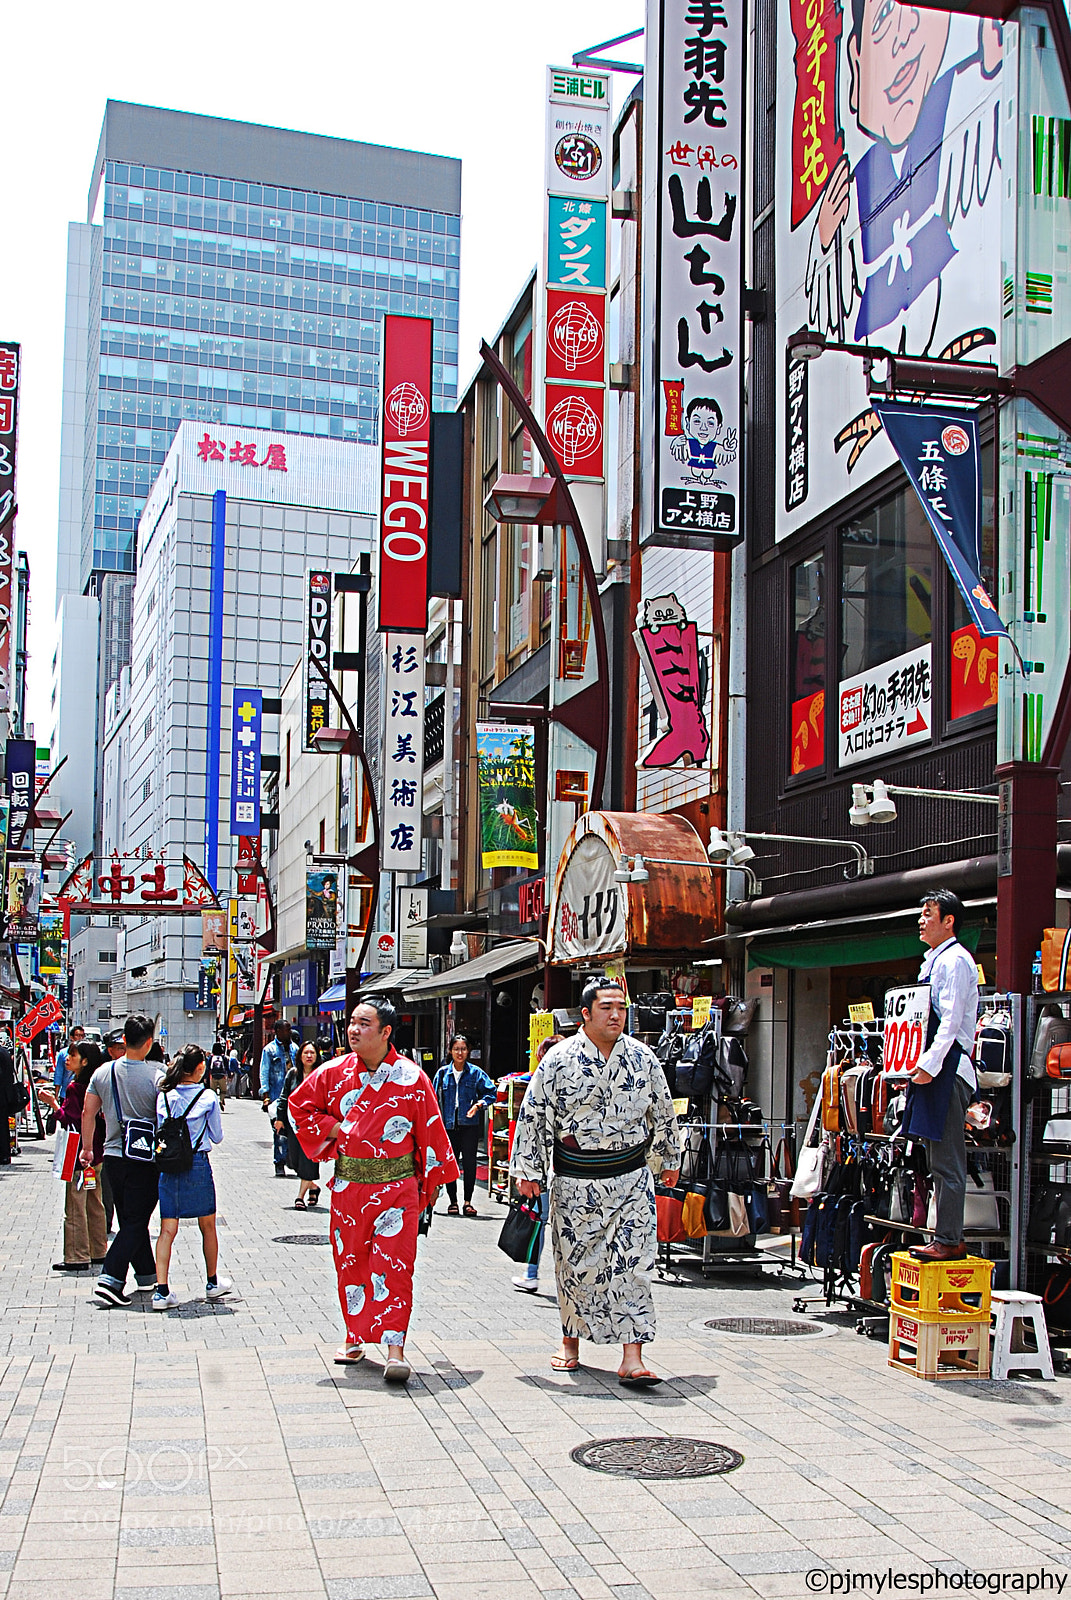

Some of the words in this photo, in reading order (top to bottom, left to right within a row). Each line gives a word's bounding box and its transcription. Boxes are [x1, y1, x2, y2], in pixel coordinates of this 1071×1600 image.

[683, 0, 728, 128] 手羽先
[553, 75, 606, 99] 三浦ビル
[665, 140, 739, 172] 世界の
[559, 216, 597, 286] ダンス
[667, 173, 738, 373] 山ちゃん
[788, 357, 807, 506] 野アメ横店
[197, 432, 288, 473] 松坂屋
[384, 440, 429, 562] WEGO
[665, 507, 731, 529] アメ横店
[678, 491, 719, 509] 上野
[863, 660, 932, 722] 幻の手羽先
[389, 645, 420, 852] 杉江美術店
[844, 715, 906, 756] 入口はコチラ
[307, 921, 337, 930] PRADO
[884, 1020, 922, 1073] 000
[898, 1267, 919, 1286] KIRIN
[945, 1334, 969, 1345] Asahi
